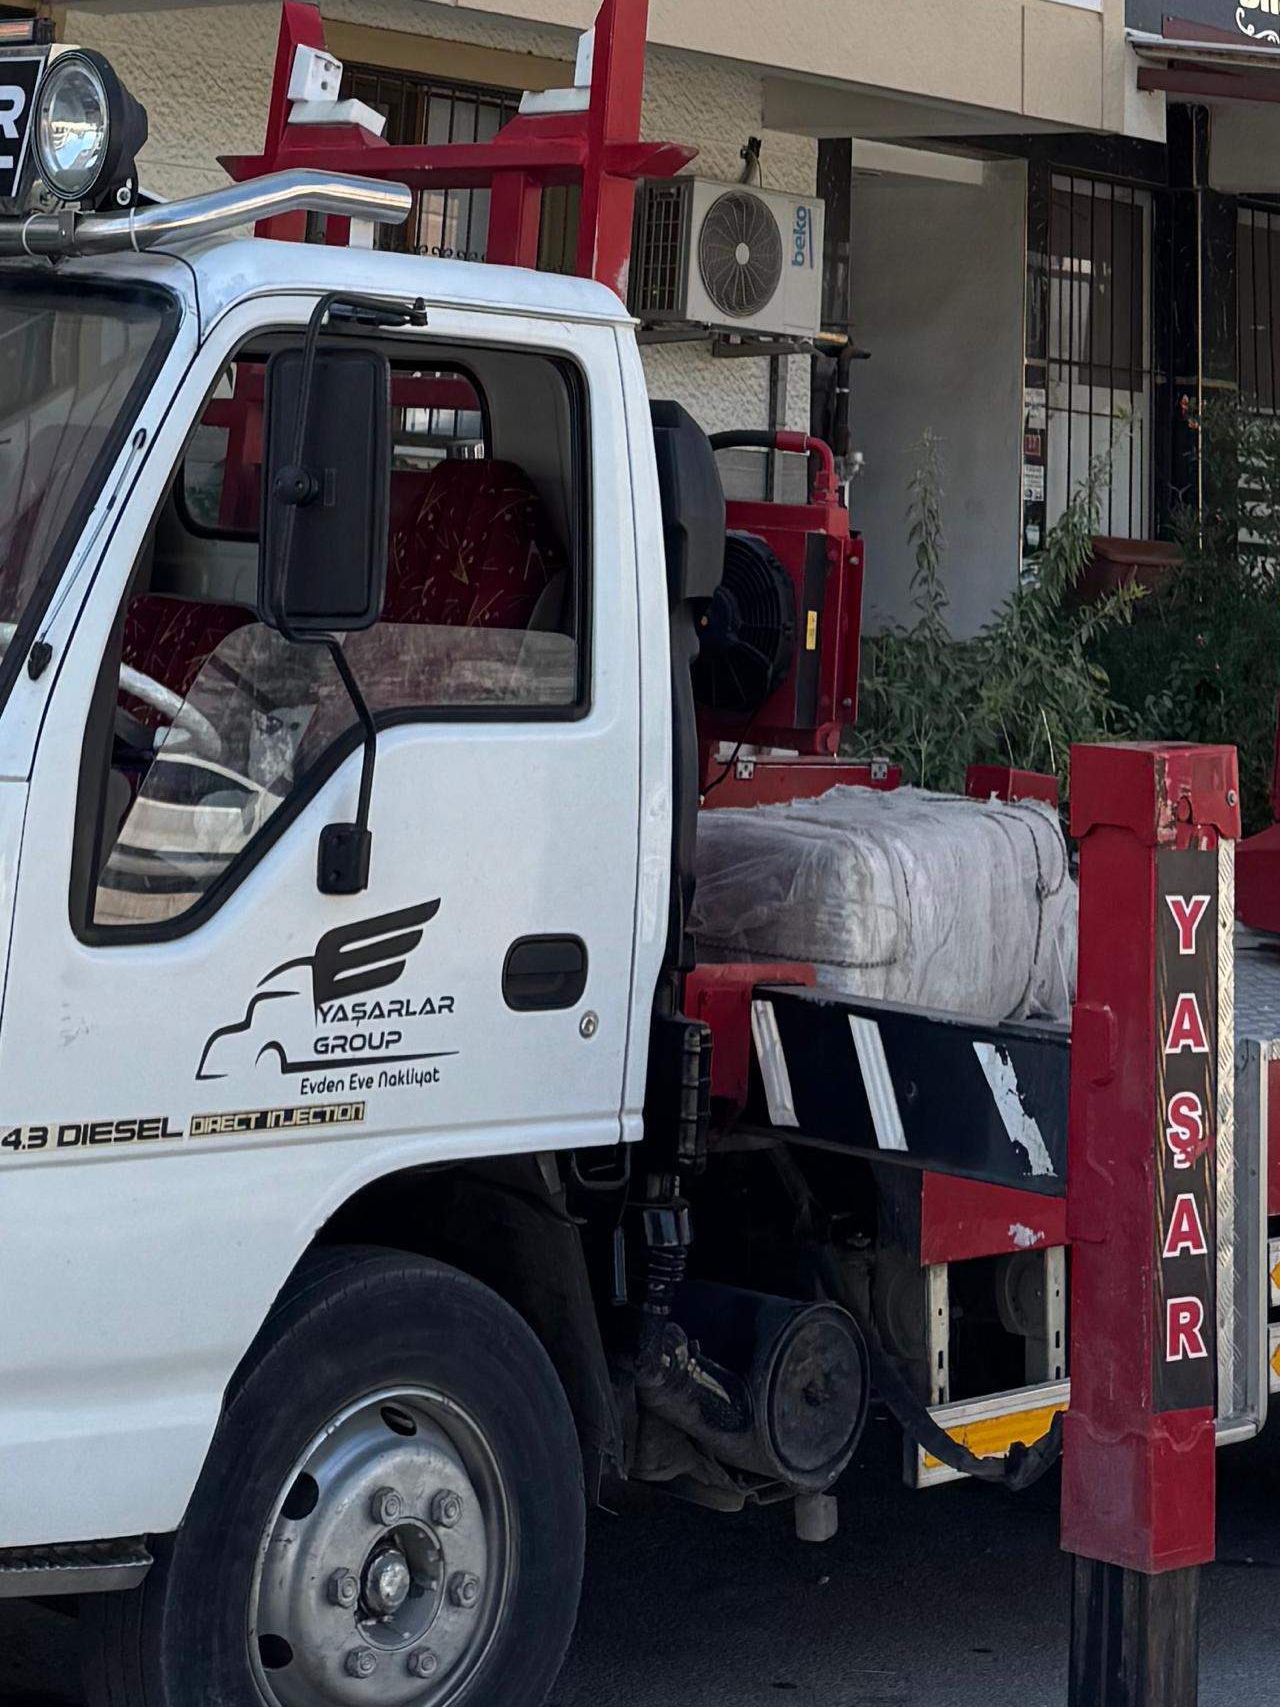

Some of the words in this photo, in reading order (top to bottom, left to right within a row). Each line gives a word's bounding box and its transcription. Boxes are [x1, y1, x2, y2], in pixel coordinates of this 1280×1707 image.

[791, 205, 808, 268] beko
[318, 995, 455, 1027] YAŞARLAR
[313, 1030, 402, 1055] GROUP
[300, 1076, 345, 1095] Evden
[349, 1073, 374, 1091] Eve
[1, 1126, 49, 1151] 4.3
[56, 1116, 184, 1147] DIESEL
[191, 1113, 258, 1134] DIRECT
[266, 1103, 364, 1128] INJECTION
[1162, 892, 1215, 1363] YAŞAR
